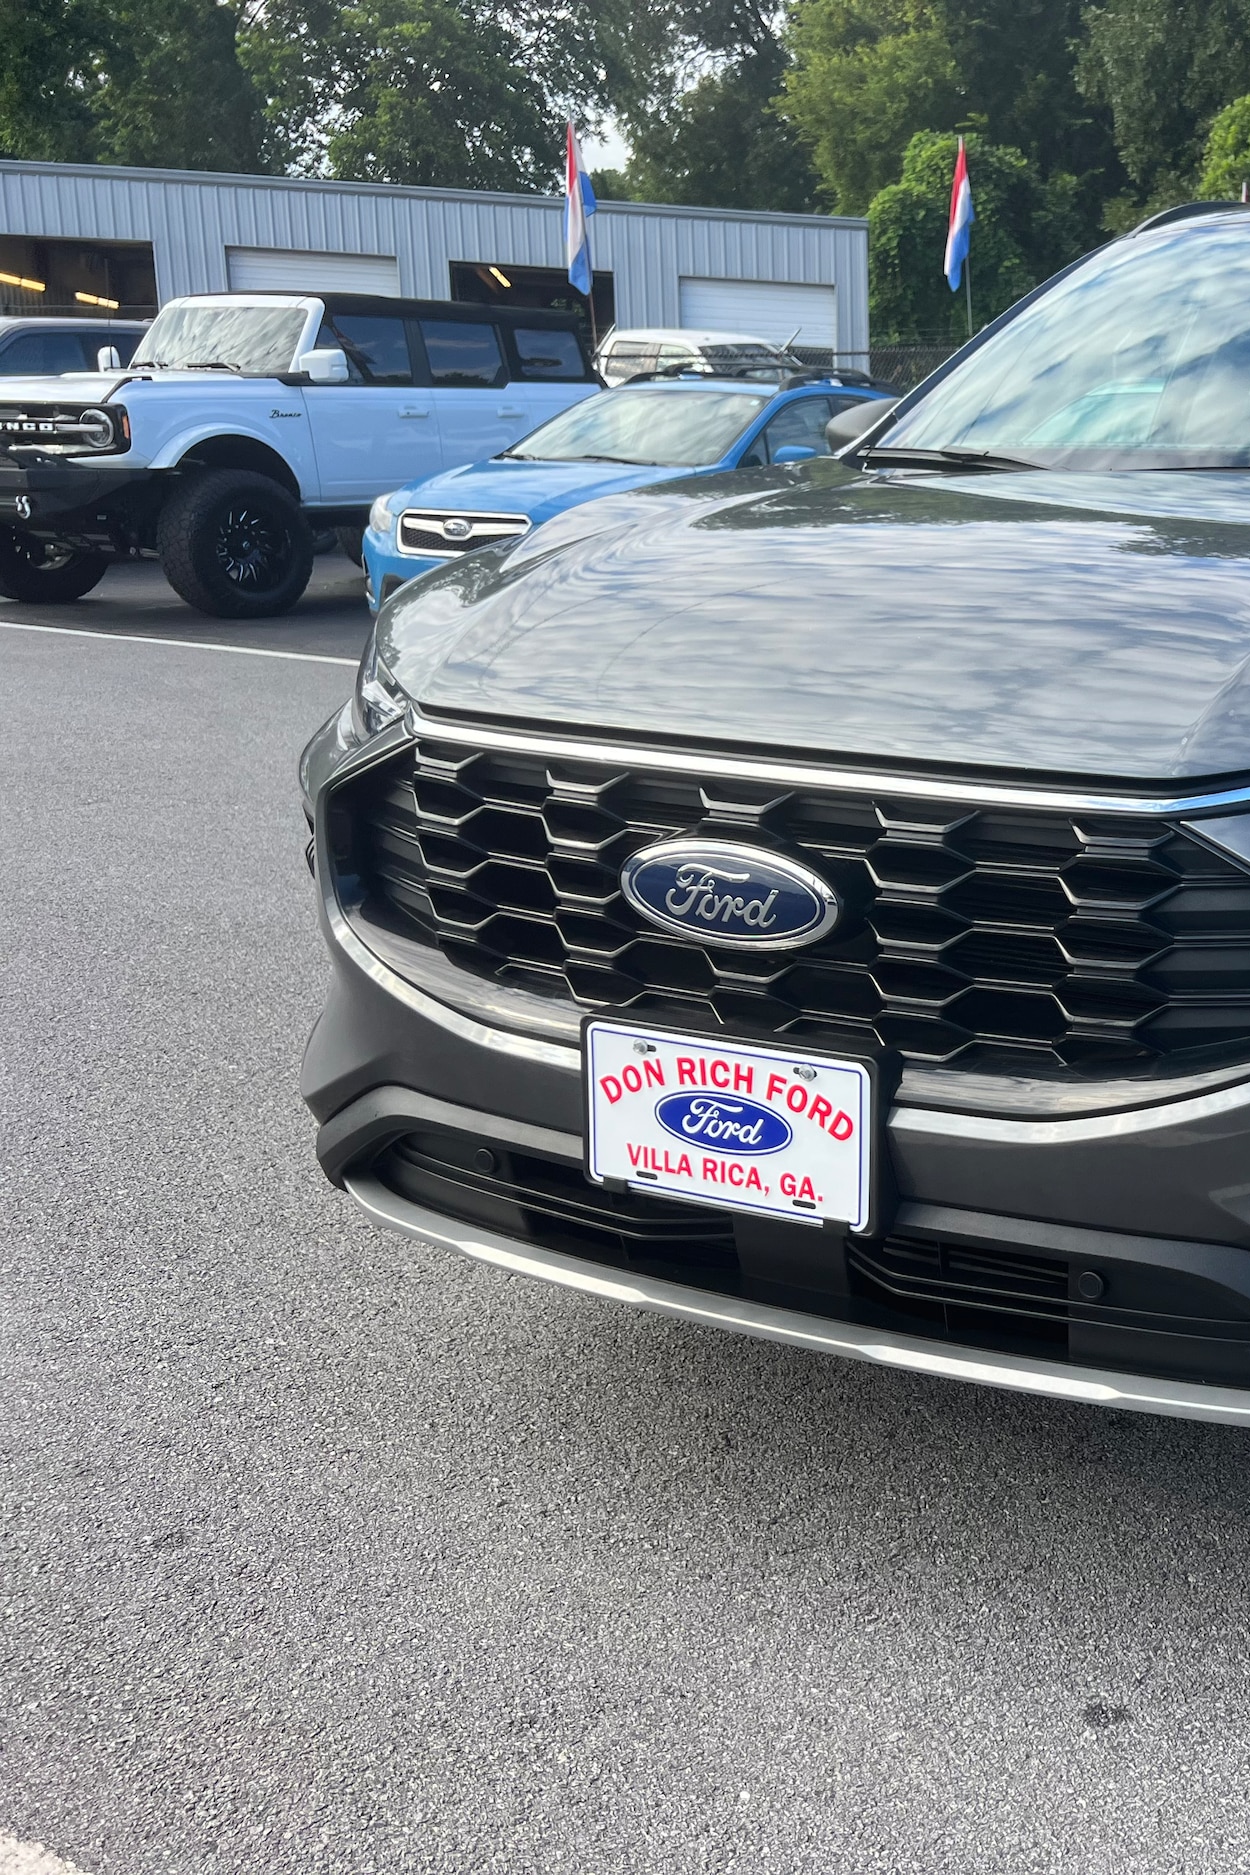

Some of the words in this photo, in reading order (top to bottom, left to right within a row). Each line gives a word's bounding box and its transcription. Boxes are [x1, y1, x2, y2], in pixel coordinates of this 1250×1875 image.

[0, 422, 54, 431] NCO
[665, 863, 779, 928] Ford
[599, 1058, 665, 1104] DON
[676, 1057, 753, 1094] RICH
[766, 1074, 854, 1141] FORD
[682, 1098, 764, 1145] Ford
[626, 1143, 693, 1178] VILLA
[702, 1157, 770, 1197] RICA,
[780, 1173, 823, 1202] GA.
